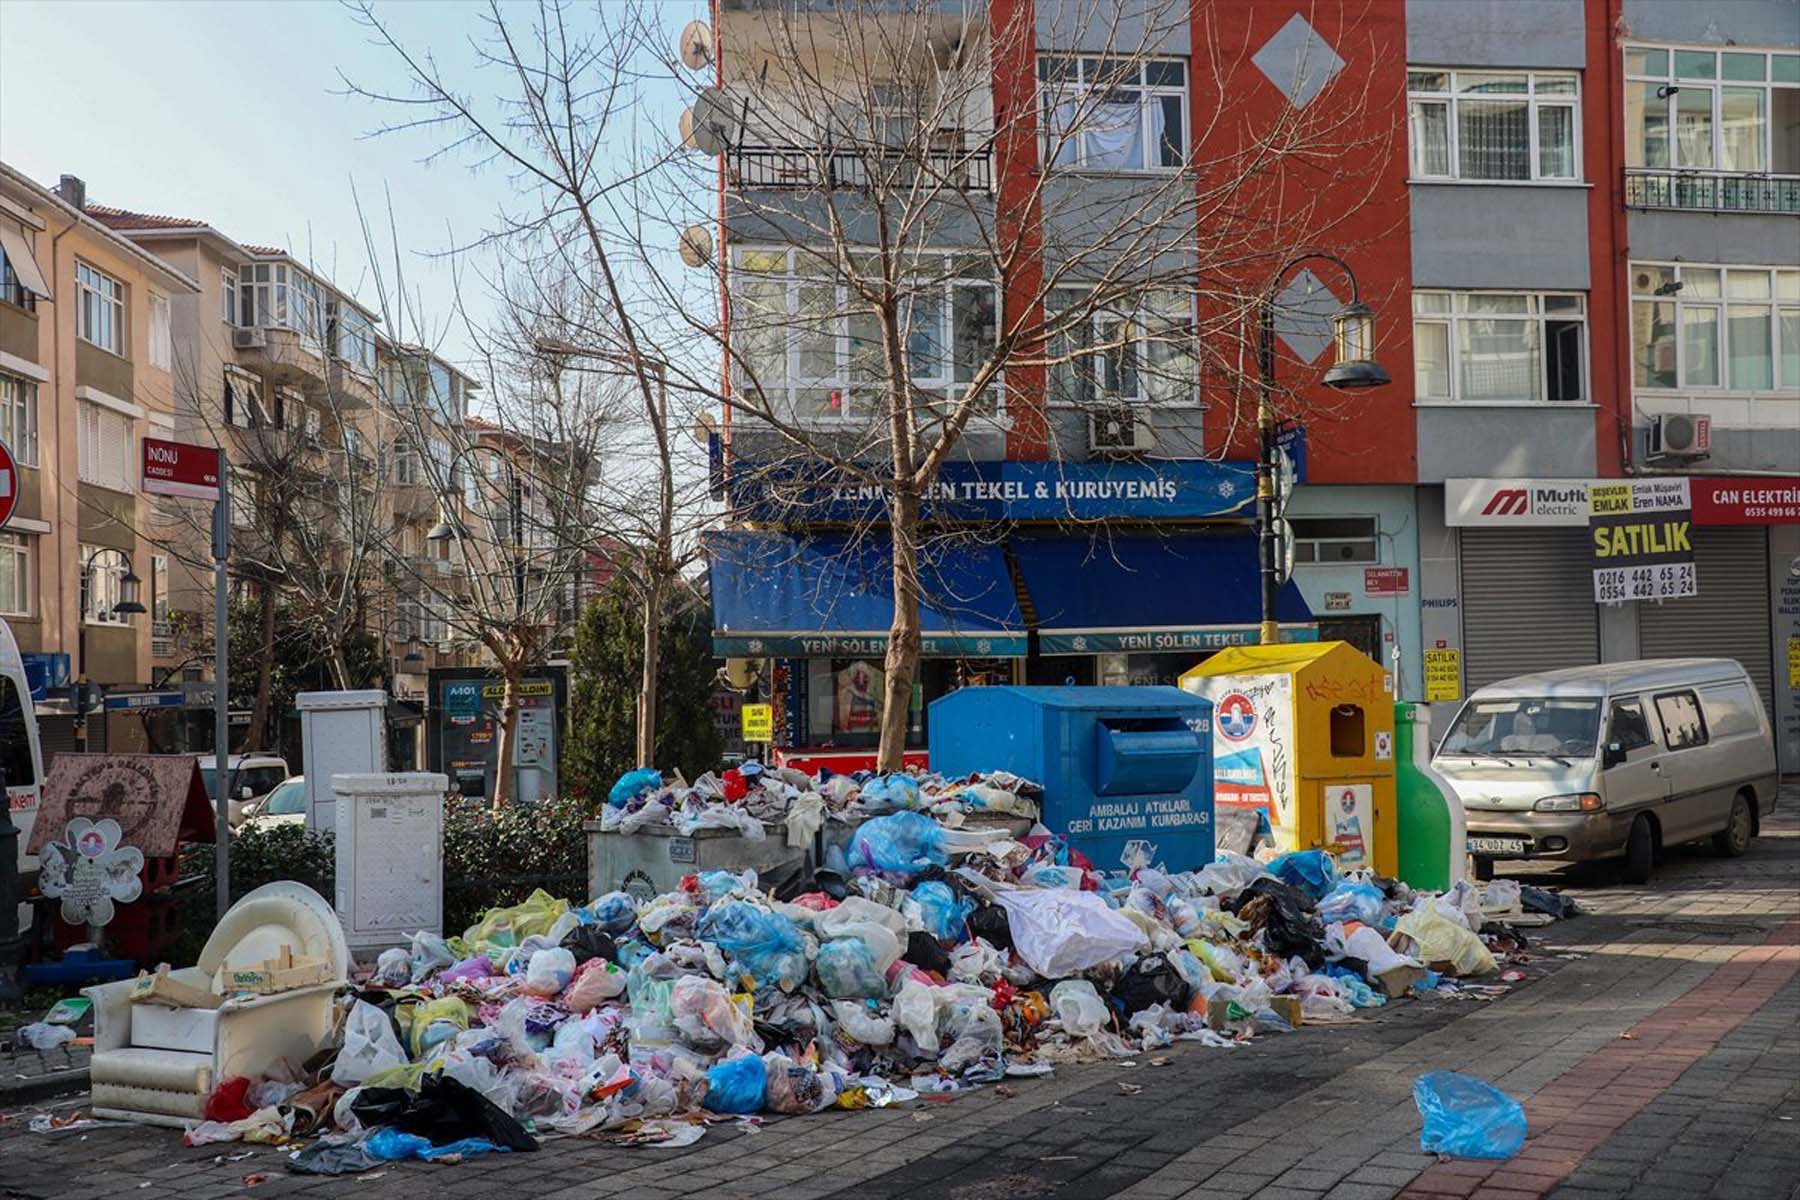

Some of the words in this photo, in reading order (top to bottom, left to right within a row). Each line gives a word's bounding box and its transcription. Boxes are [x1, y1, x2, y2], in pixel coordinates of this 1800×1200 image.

[961, 481, 1029, 500] TEKEL
[1034, 481, 1050, 500] &
[1055, 477, 1177, 503] KURUYEMİŞ
[1712, 490, 1739, 505] CAN
[1592, 498, 1629, 513] EMLAK
[1632, 498, 1654, 509] Eren
[1655, 494, 1684, 507] NAMA
[1536, 503, 1578, 516] electric
[1744, 507, 1766, 517] 0535
[1593, 521, 1693, 558] SATILIK
[1599, 570, 1626, 586] 0216
[1631, 568, 1653, 583] 442
[1659, 567, 1674, 581] 65
[1679, 565, 1693, 580] 24
[1599, 585, 1627, 600] 0554
[1632, 583, 1654, 597] 442
[1660, 581, 1675, 595] 65
[1680, 579, 1694, 594] 24
[1422, 598, 1457, 608] PHILIPS
[801, 637, 838, 653] YENİ
[1118, 632, 1151, 649] YENİ
[1155, 633, 1200, 650] ŞÖLEN
[1204, 632, 1248, 646] TEKEL
[1427, 652, 1457, 664] SATILIK
[1089, 803, 1139, 818] AMBALAJ
[1145, 799, 1191, 815] ATIKLARI
[1098, 815, 1147, 832] KAZANIM
[1151, 811, 1210, 827] KUMBARASI
[1510, 839, 1522, 851] 45
